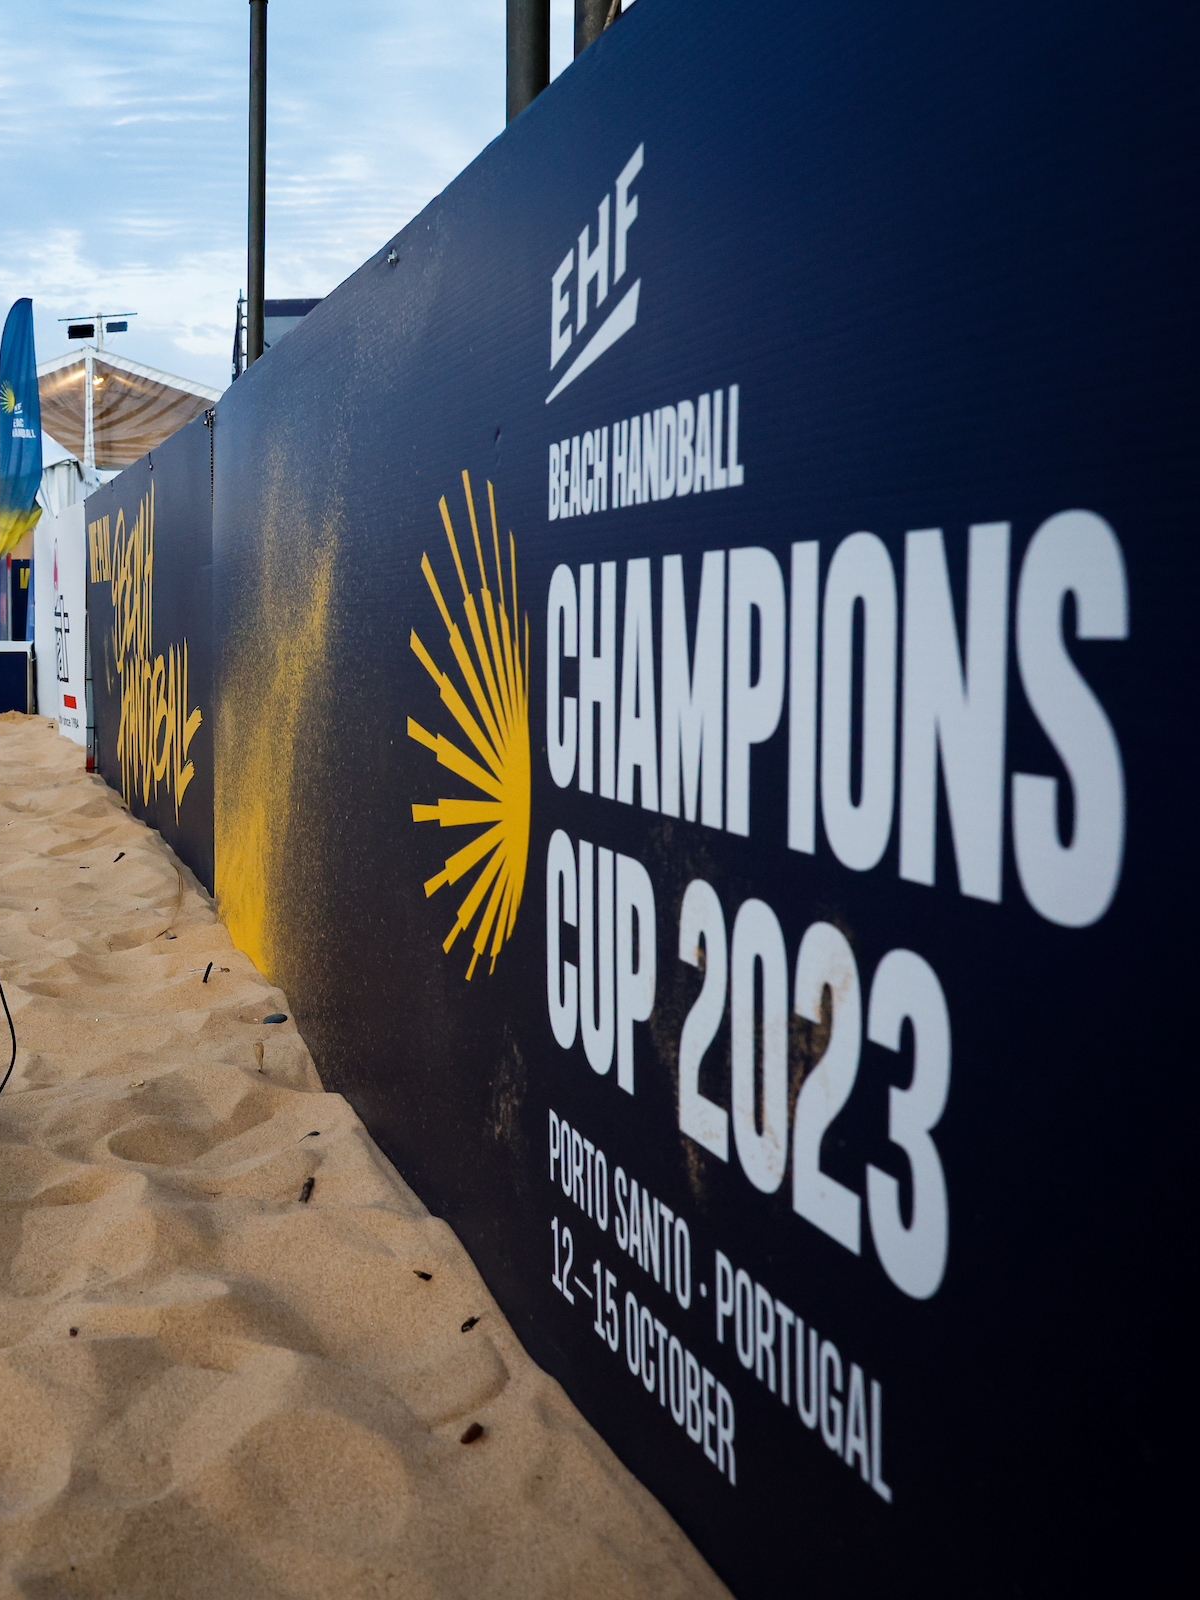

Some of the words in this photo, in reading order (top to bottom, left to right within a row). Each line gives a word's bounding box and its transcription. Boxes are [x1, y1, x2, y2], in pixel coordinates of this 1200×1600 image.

[550, 142, 644, 371] EHF
[548, 426, 609, 521] BEACH
[612, 383, 744, 508] HANDBALL
[88, 521, 100, 583] WE
[111, 478, 154, 674] BEACH
[117, 636, 203, 826] HANDBALL
[546, 508, 1129, 929] CHAMPIONS
[546, 829, 657, 1095] CUP
[678, 878, 953, 1300] 2023
[548, 1108, 608, 1231] PORTO
[614, 1166, 691, 1309] SANTO
[716, 1249, 893, 1504] PORTUGAL
[625, 1291, 736, 1487] OCTOBER
